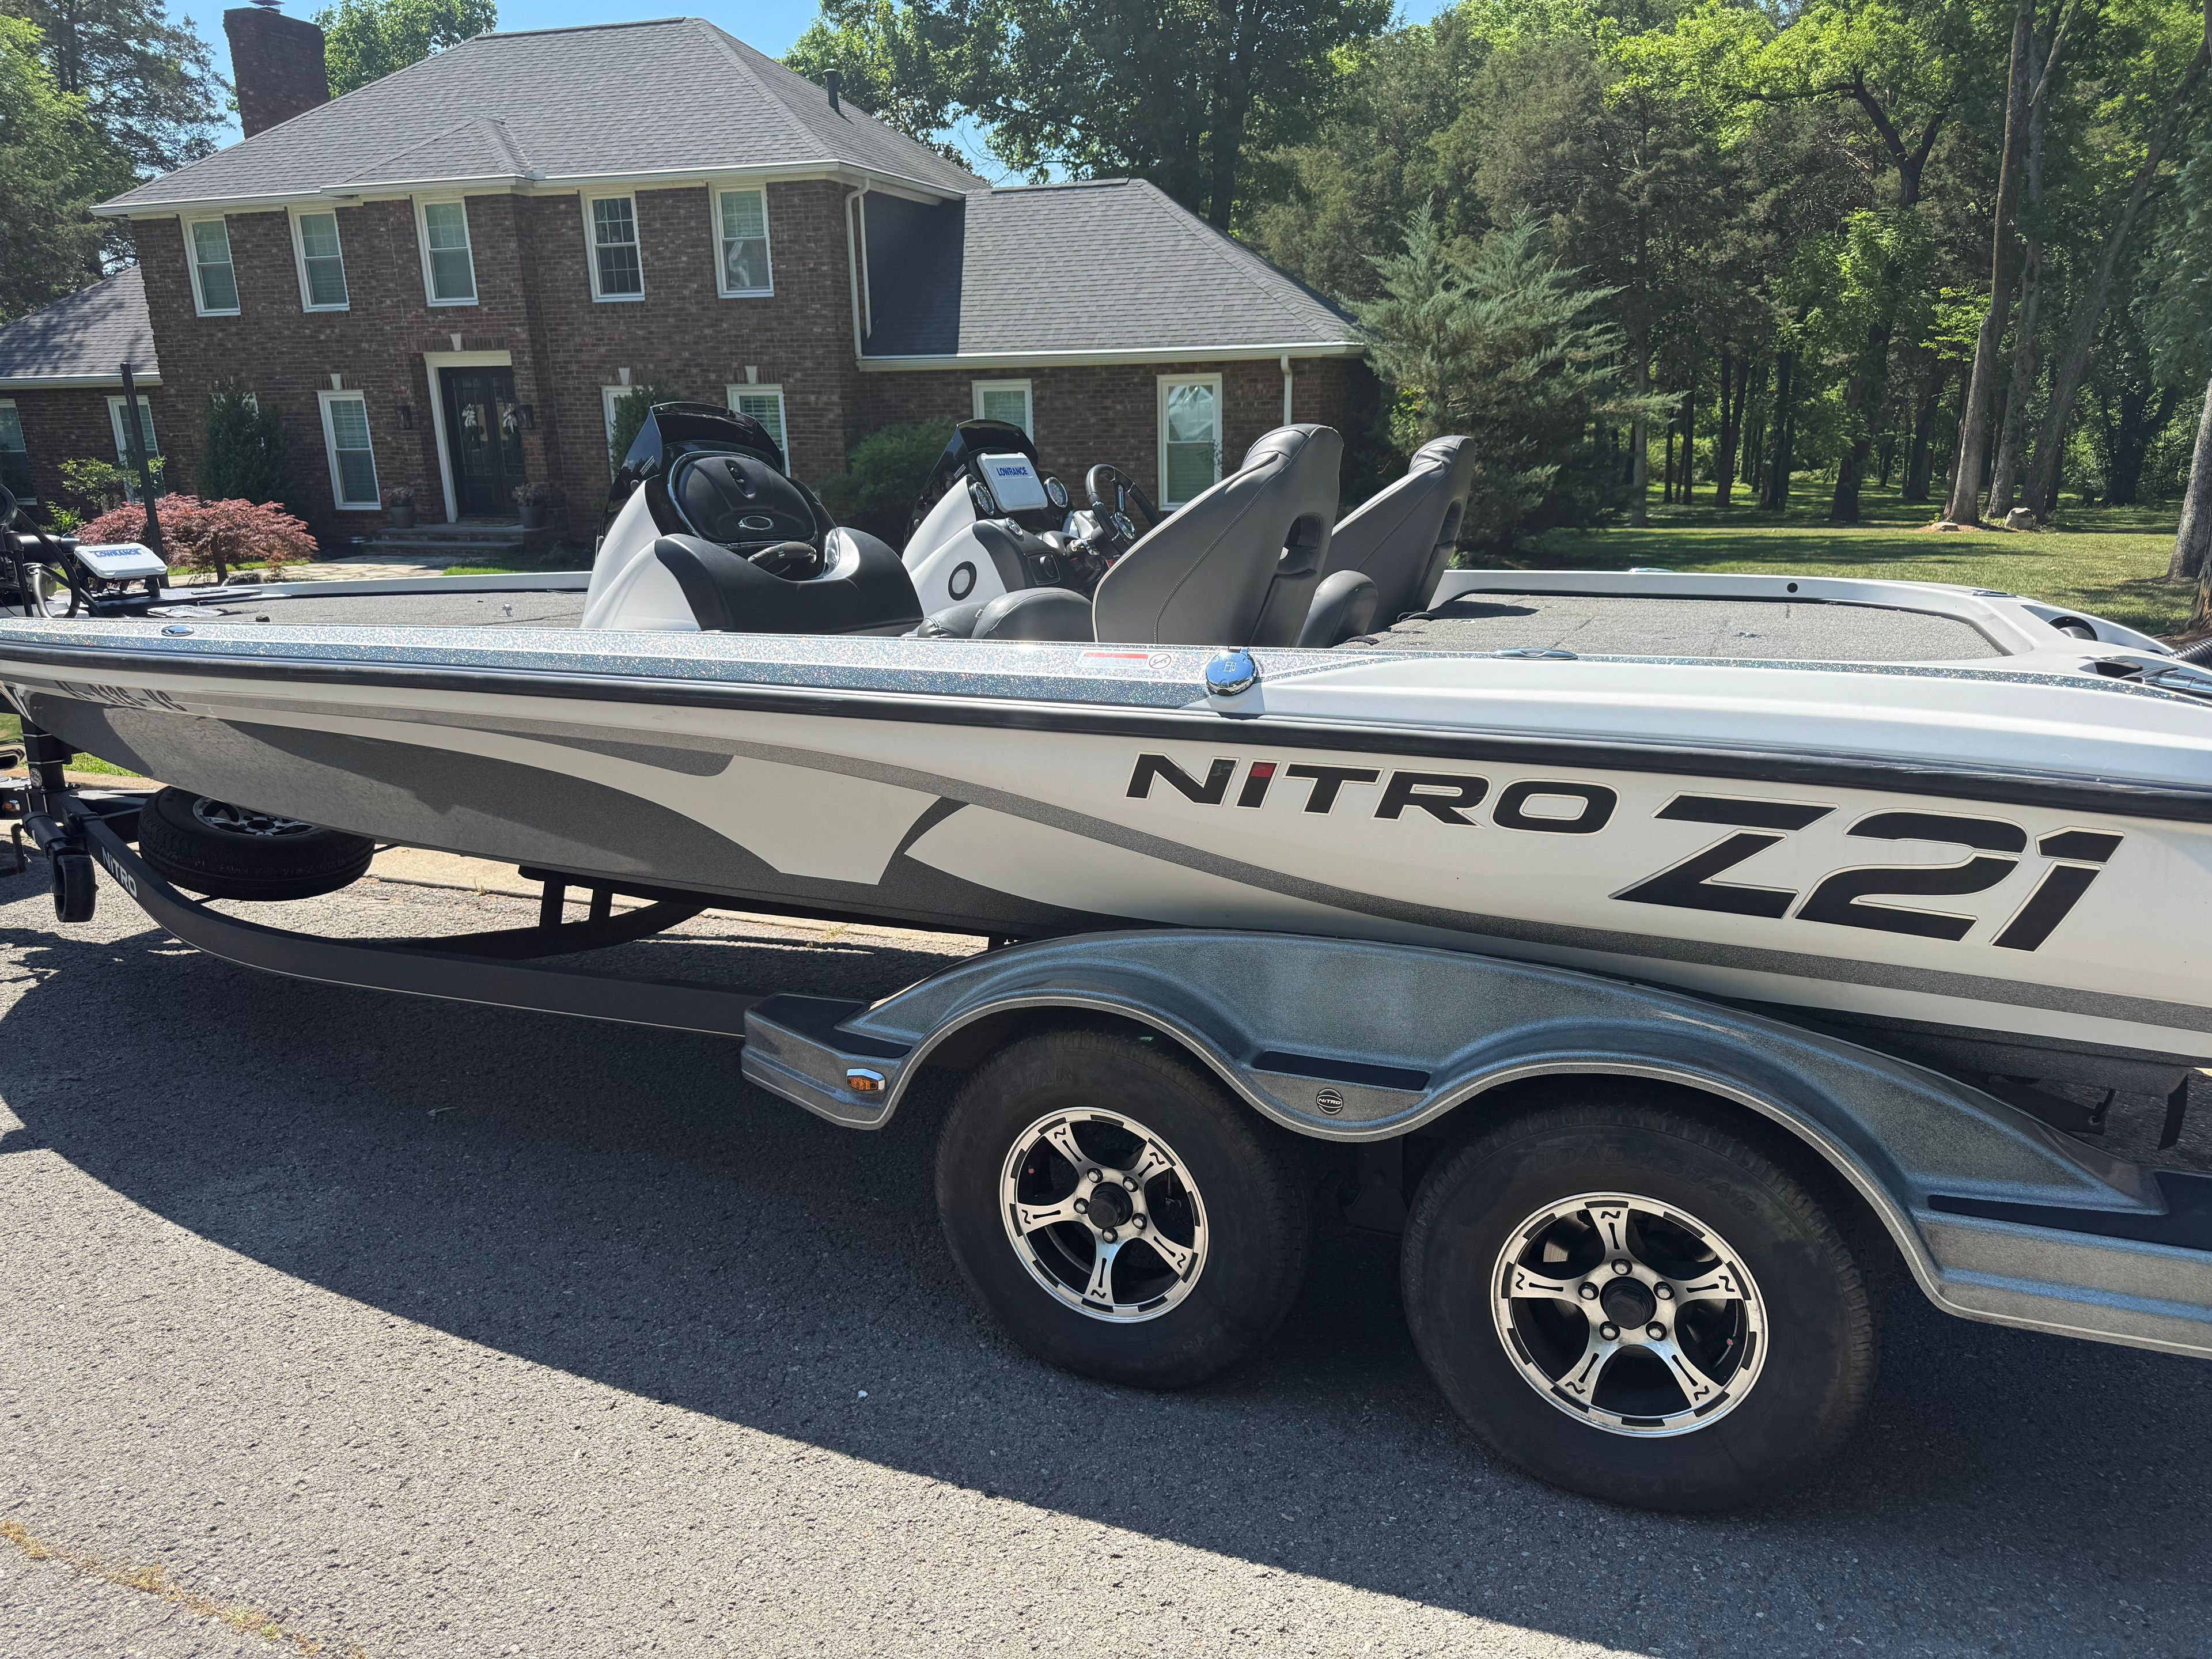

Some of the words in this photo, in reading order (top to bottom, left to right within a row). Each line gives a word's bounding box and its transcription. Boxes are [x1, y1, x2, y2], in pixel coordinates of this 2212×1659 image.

[996, 467, 1028, 476] LOWRANCE
[93, 548, 142, 558] LOWRANCE
[1126, 752, 1618, 835] NITRO
[1609, 792, 2124, 952] Z21
[1318, 1097, 1342, 1105] NITRO
[1662, 1159, 1758, 1215] STAR
